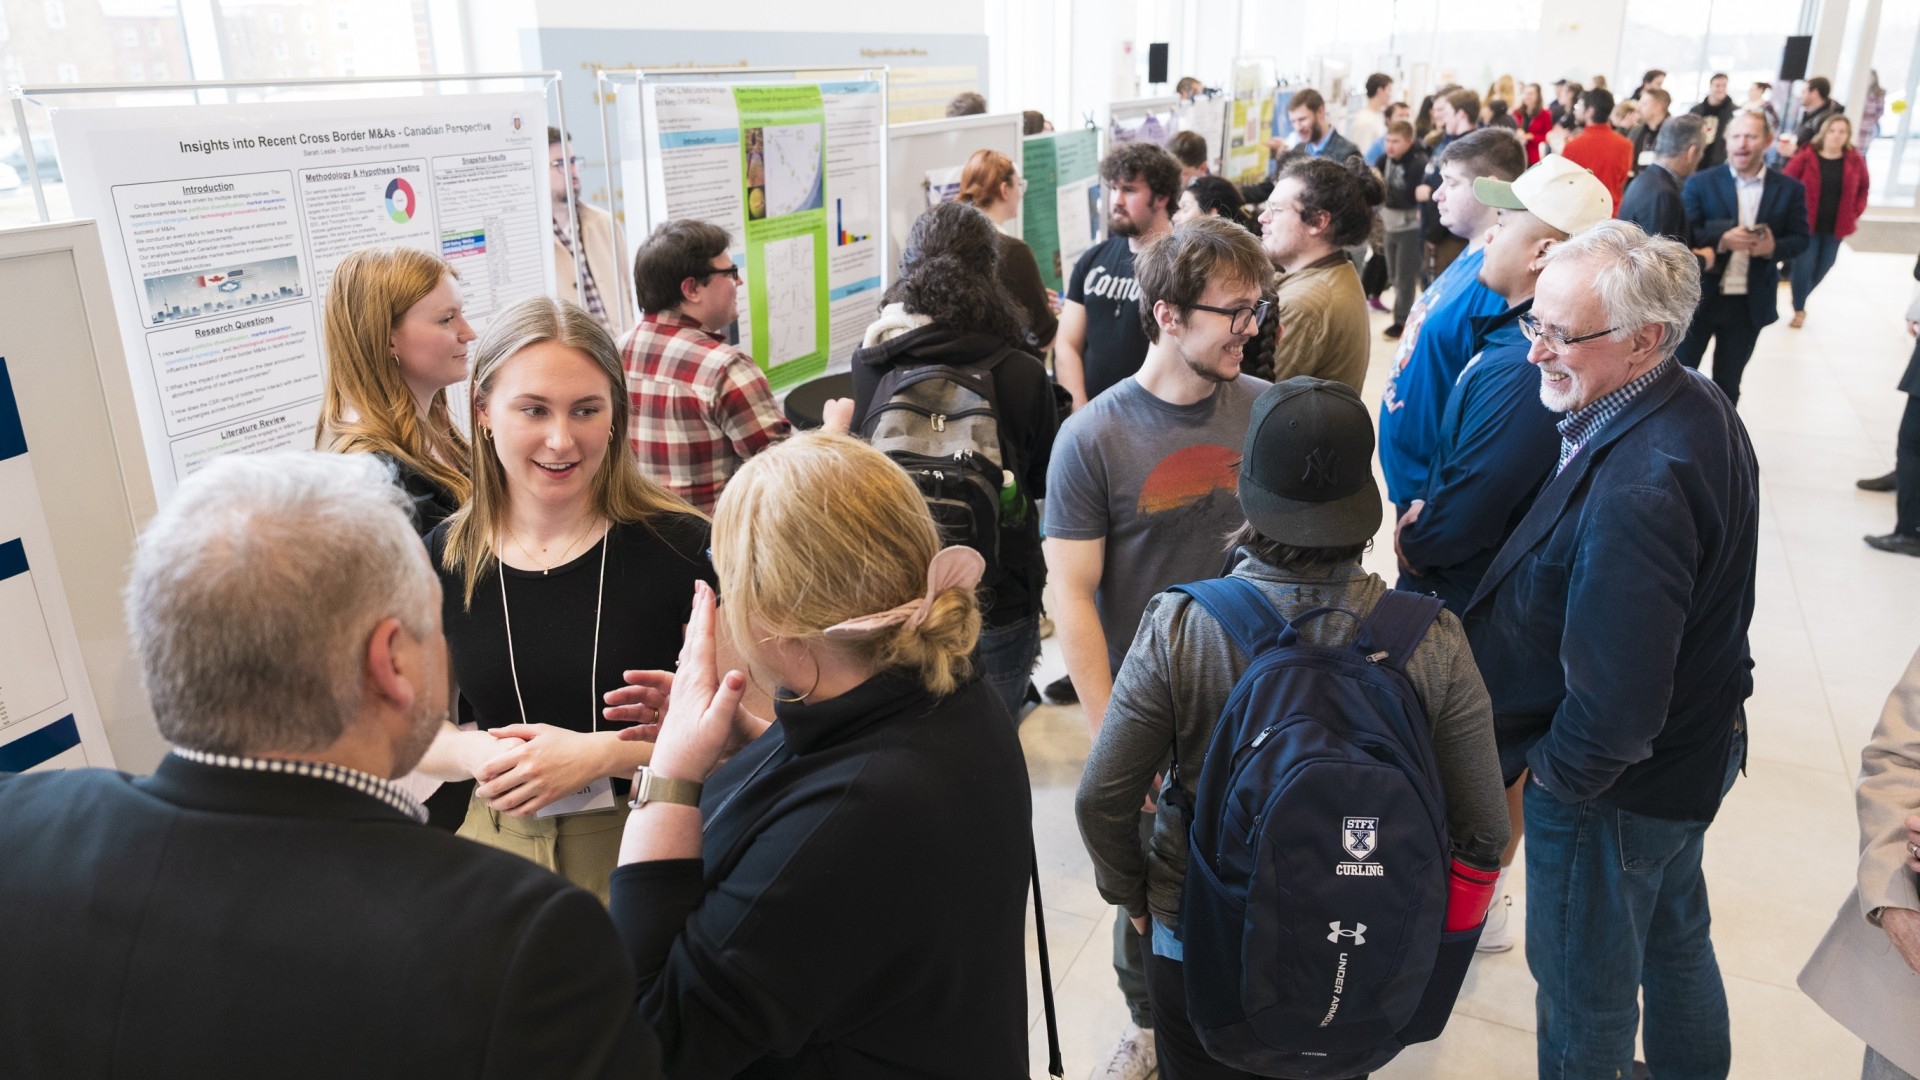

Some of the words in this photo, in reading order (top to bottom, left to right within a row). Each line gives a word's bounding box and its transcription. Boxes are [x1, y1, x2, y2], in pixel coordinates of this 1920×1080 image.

[180, 139, 229, 154] Insights
[232, 138, 255, 149] into
[258, 135, 296, 147] Recent
[299, 133, 330, 144] Cross
[332, 129, 365, 142] Border
[369, 128, 396, 140] M&As
[404, 124, 443, 137] Canadian
[446, 122, 492, 134] Perspective
[462, 157, 487, 165] Snapshot
[306, 172, 350, 181] Methodology
[360, 167, 395, 177] Hypothesis
[397, 165, 419, 174] Testing
[183, 183, 234, 195] Introduction
[195, 323, 233, 337] Research
[235, 316, 274, 329] Questions
[221, 423, 257, 440] Literature
[260, 416, 286, 428] Review
[1347, 820, 1375, 829] STFX
[1351, 831, 1370, 851] X
[1336, 865, 1384, 876] CURLING
[1334, 953, 1348, 994] UNDER
